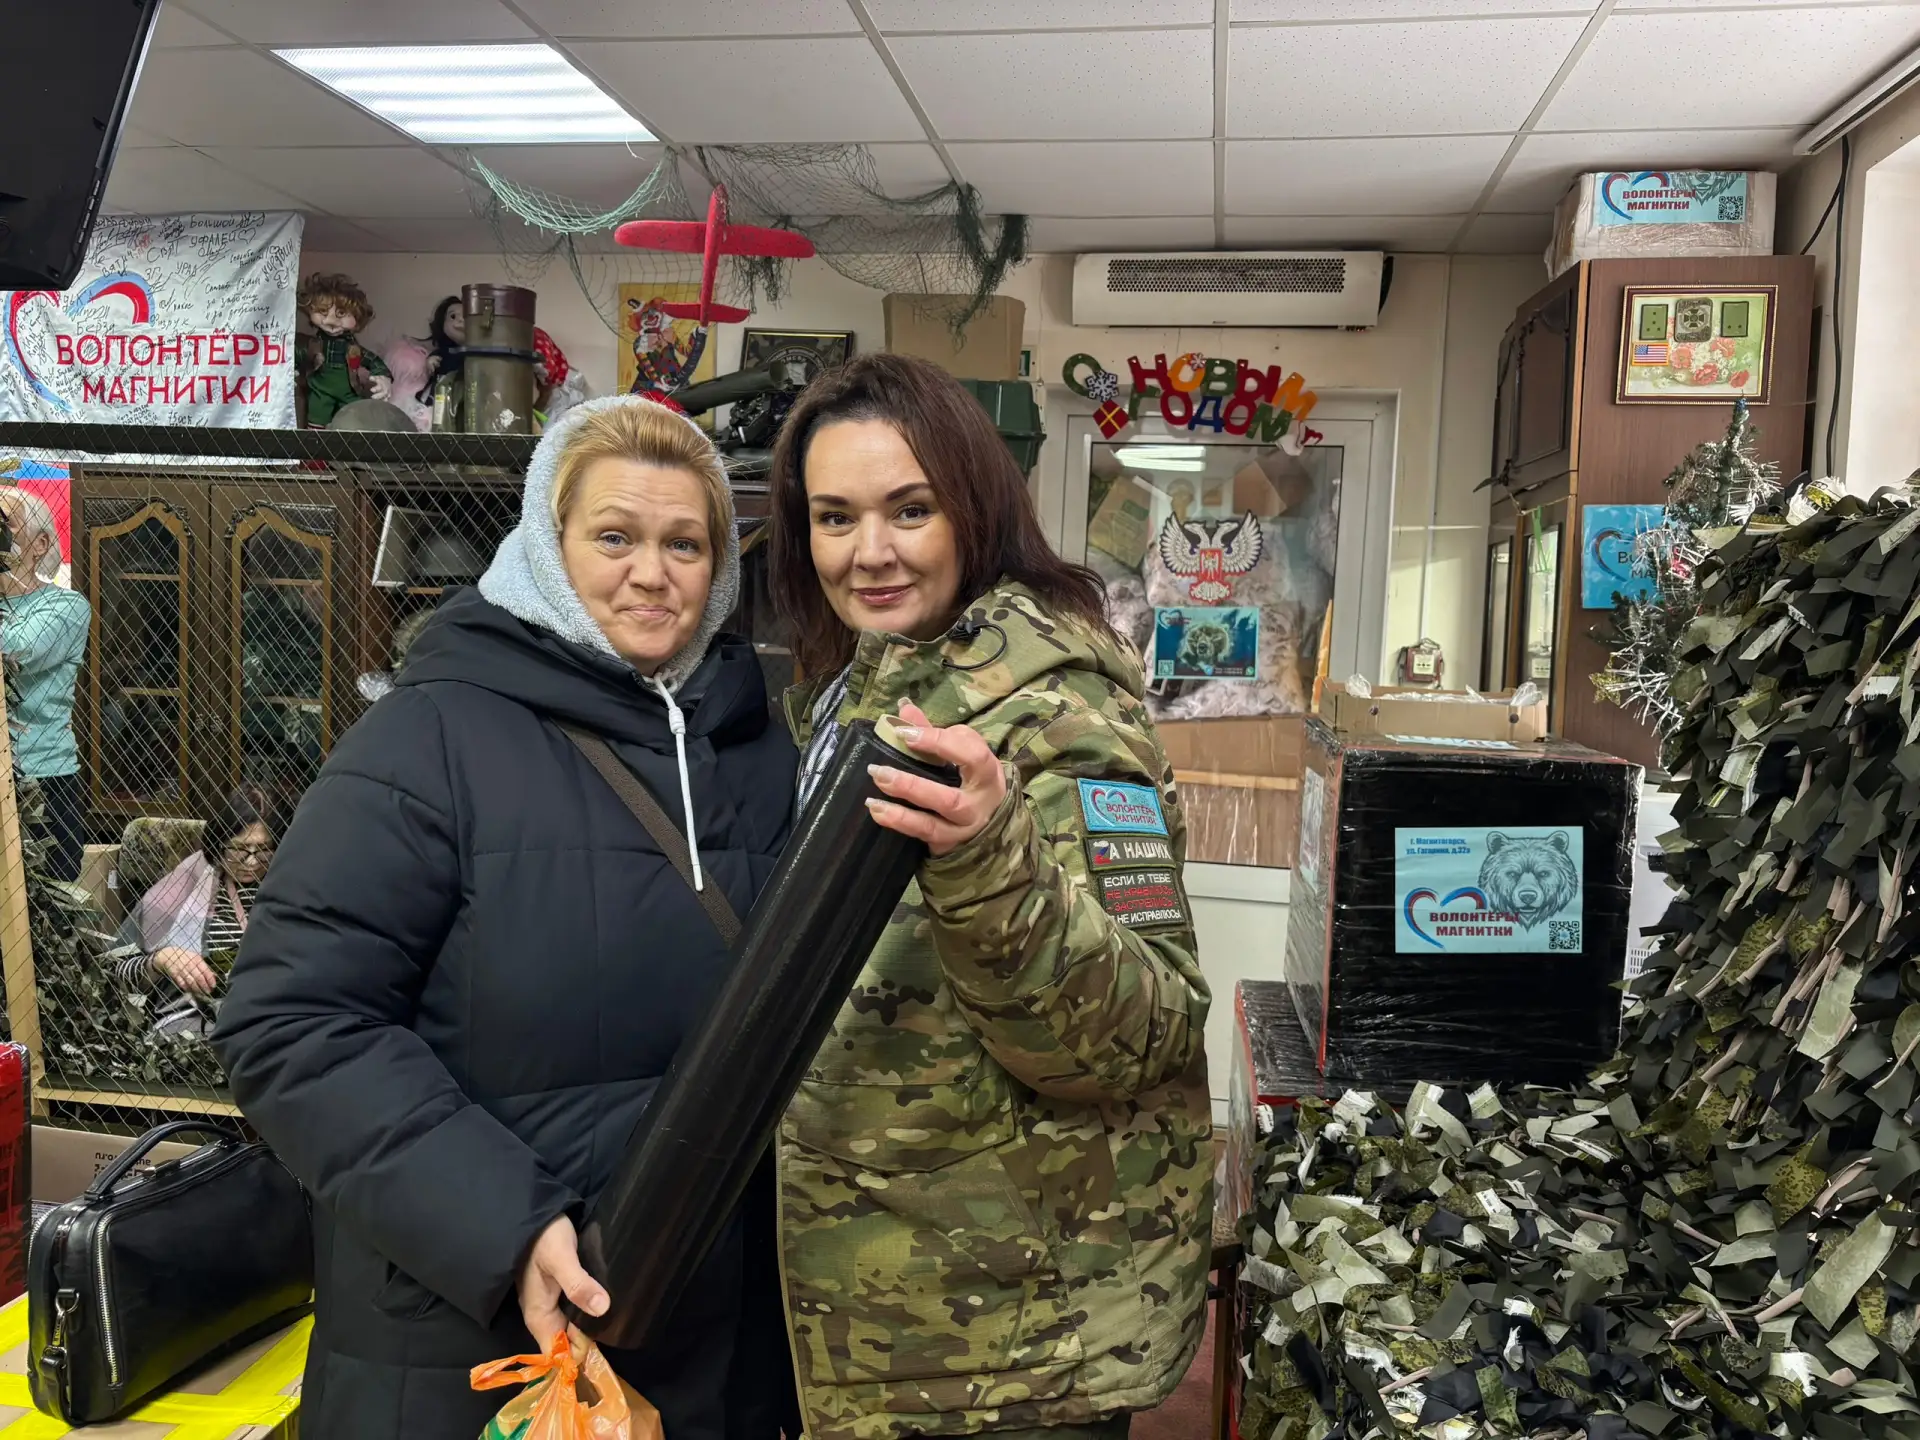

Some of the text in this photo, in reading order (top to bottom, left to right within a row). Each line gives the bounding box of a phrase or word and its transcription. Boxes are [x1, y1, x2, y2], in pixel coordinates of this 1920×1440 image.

[1627, 201, 1690, 211] МАГНИТКИ
[56, 328, 287, 366] ВОЛОНТЁРЫ
[82, 375, 271, 405] МАГНИТКИ
[1127, 353, 1319, 421] НОВЫМ
[1128, 383, 1293, 443] ГОДОМ
[1123, 842, 1173, 860] НАШИХ
[1104, 873, 1172, 888] ЕСЛИ Я ТЕБЕ
[1105, 889, 1123, 900] НЕ
[1117, 914, 1130, 924] НЕ
[1436, 926, 1513, 937] МАГНИТКИ
